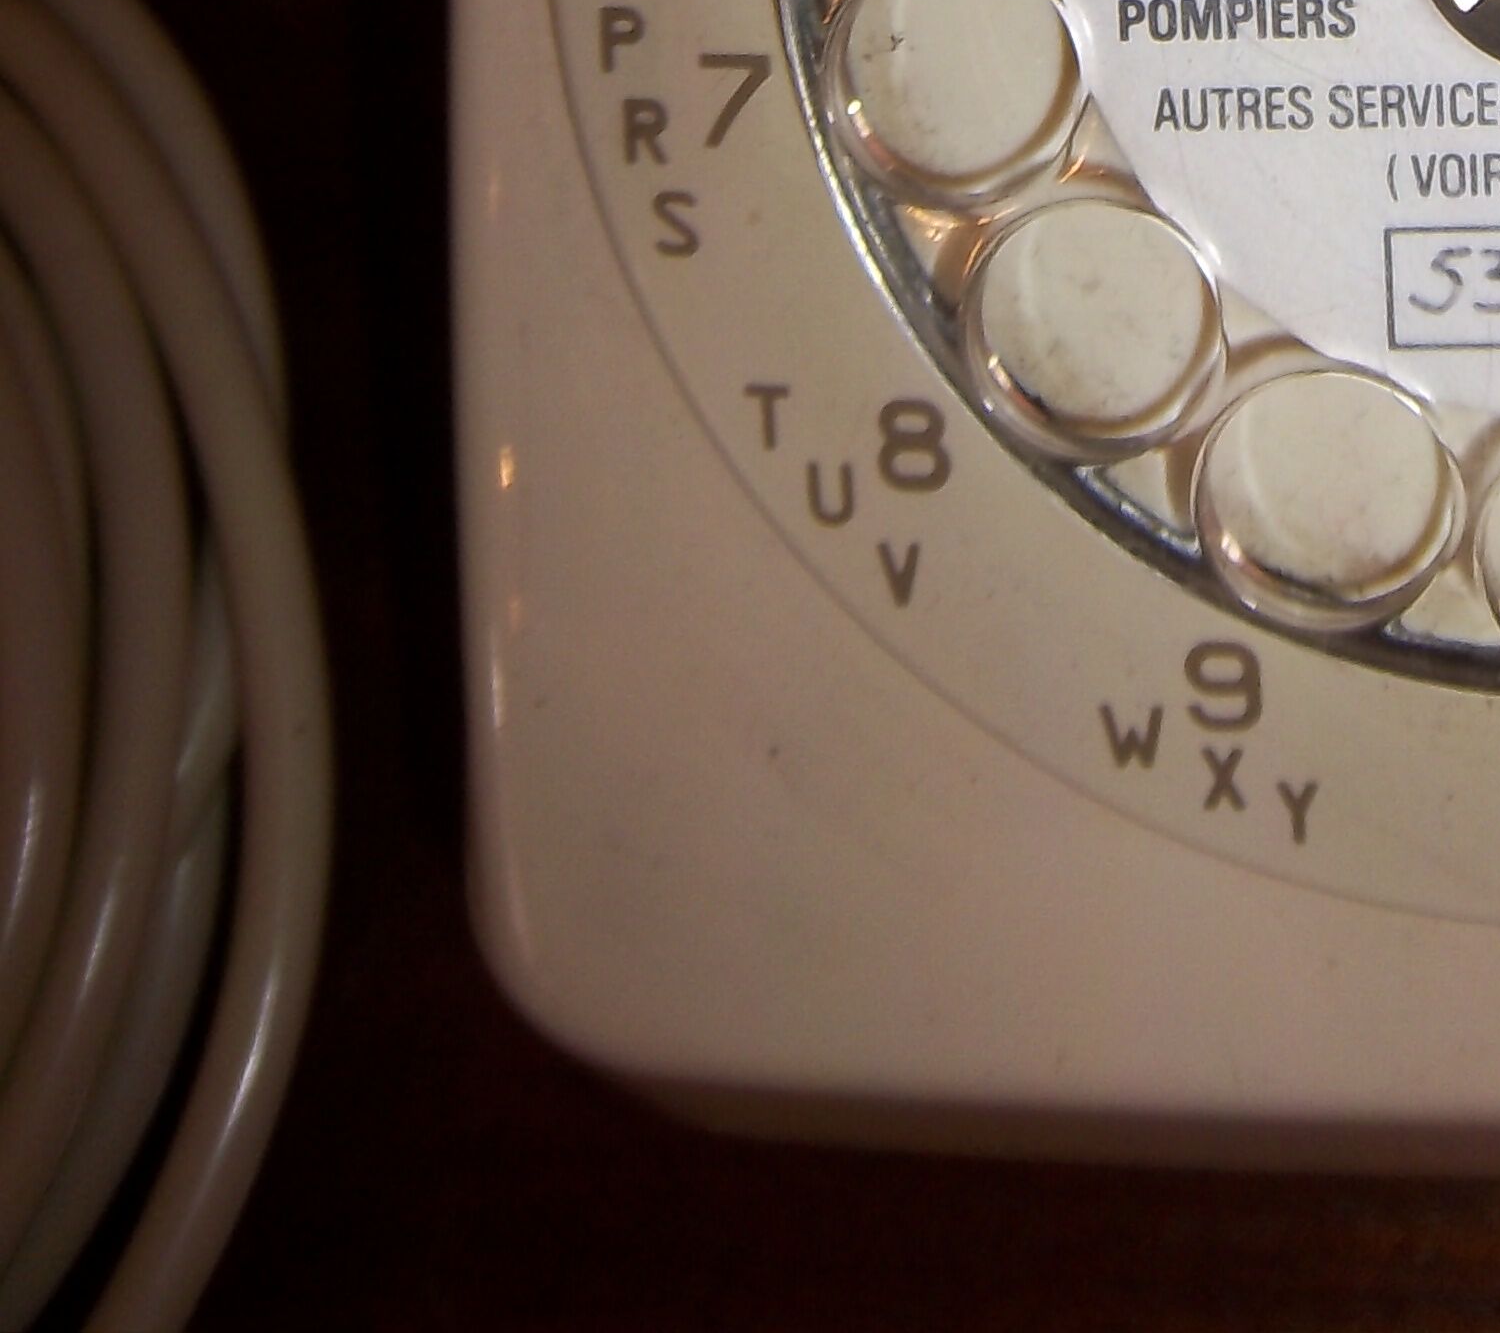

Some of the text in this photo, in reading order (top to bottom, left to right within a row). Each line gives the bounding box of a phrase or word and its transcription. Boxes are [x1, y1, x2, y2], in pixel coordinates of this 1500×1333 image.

[700, 53, 772, 149] 7
[1152, 83, 1316, 134] AUTRES
[876, 398, 951, 493] 8
[1183, 639, 1263, 733] 9
